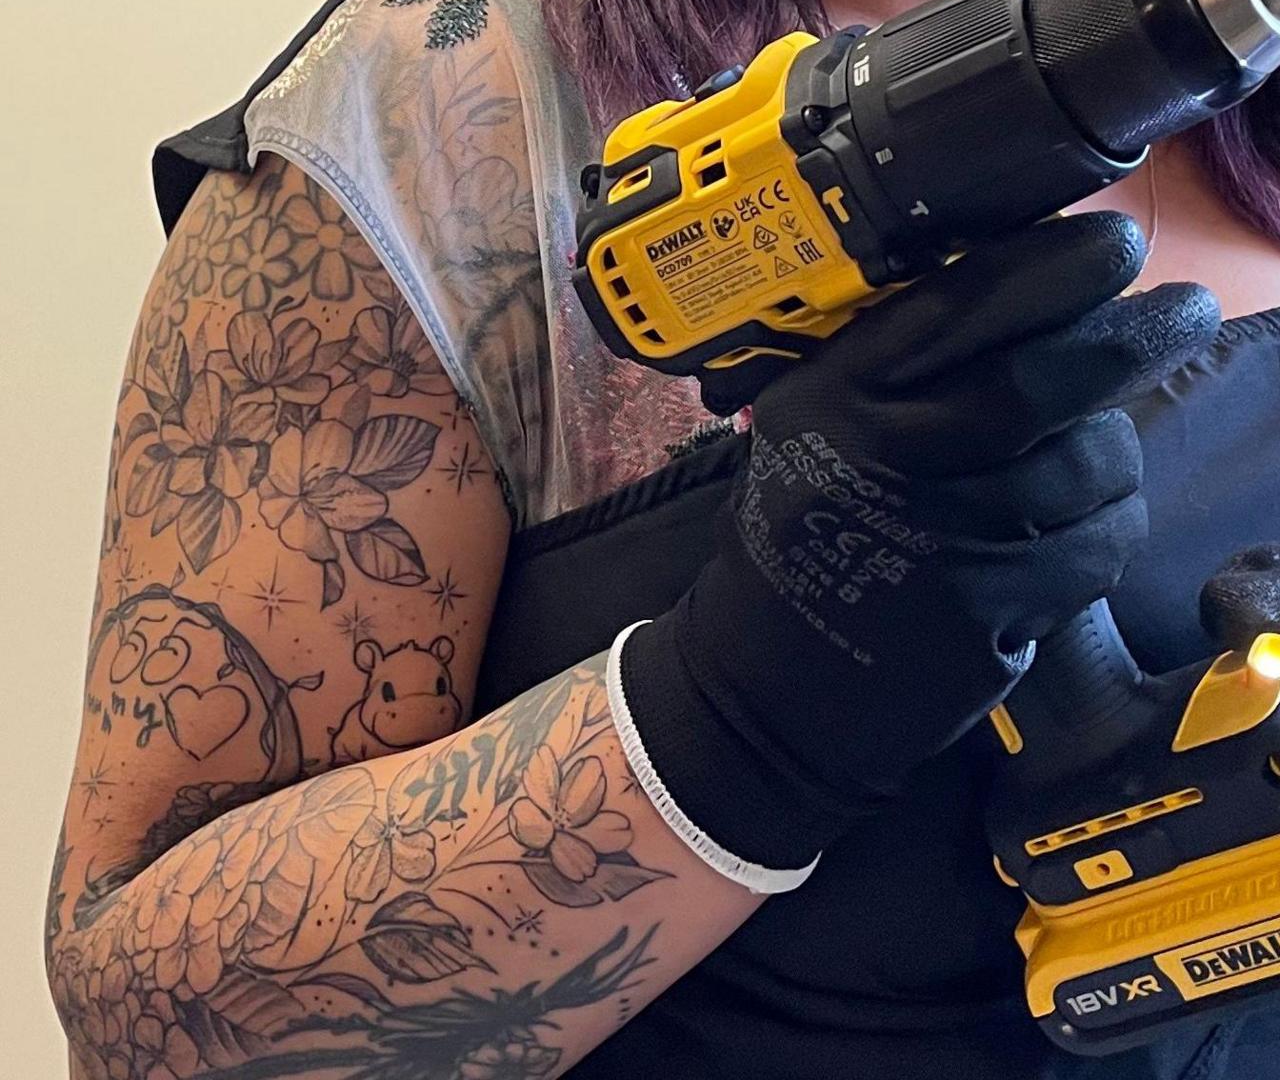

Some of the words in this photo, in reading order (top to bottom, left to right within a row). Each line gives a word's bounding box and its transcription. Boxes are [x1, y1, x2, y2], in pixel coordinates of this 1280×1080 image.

[853, 55, 870, 87] 15
[734, 193, 755, 211] UK
[740, 206, 762, 222] CA
[656, 254, 693, 278] DCD709
[1065, 985, 1120, 1017] 18V
[1120, 973, 1164, 1003] XR
